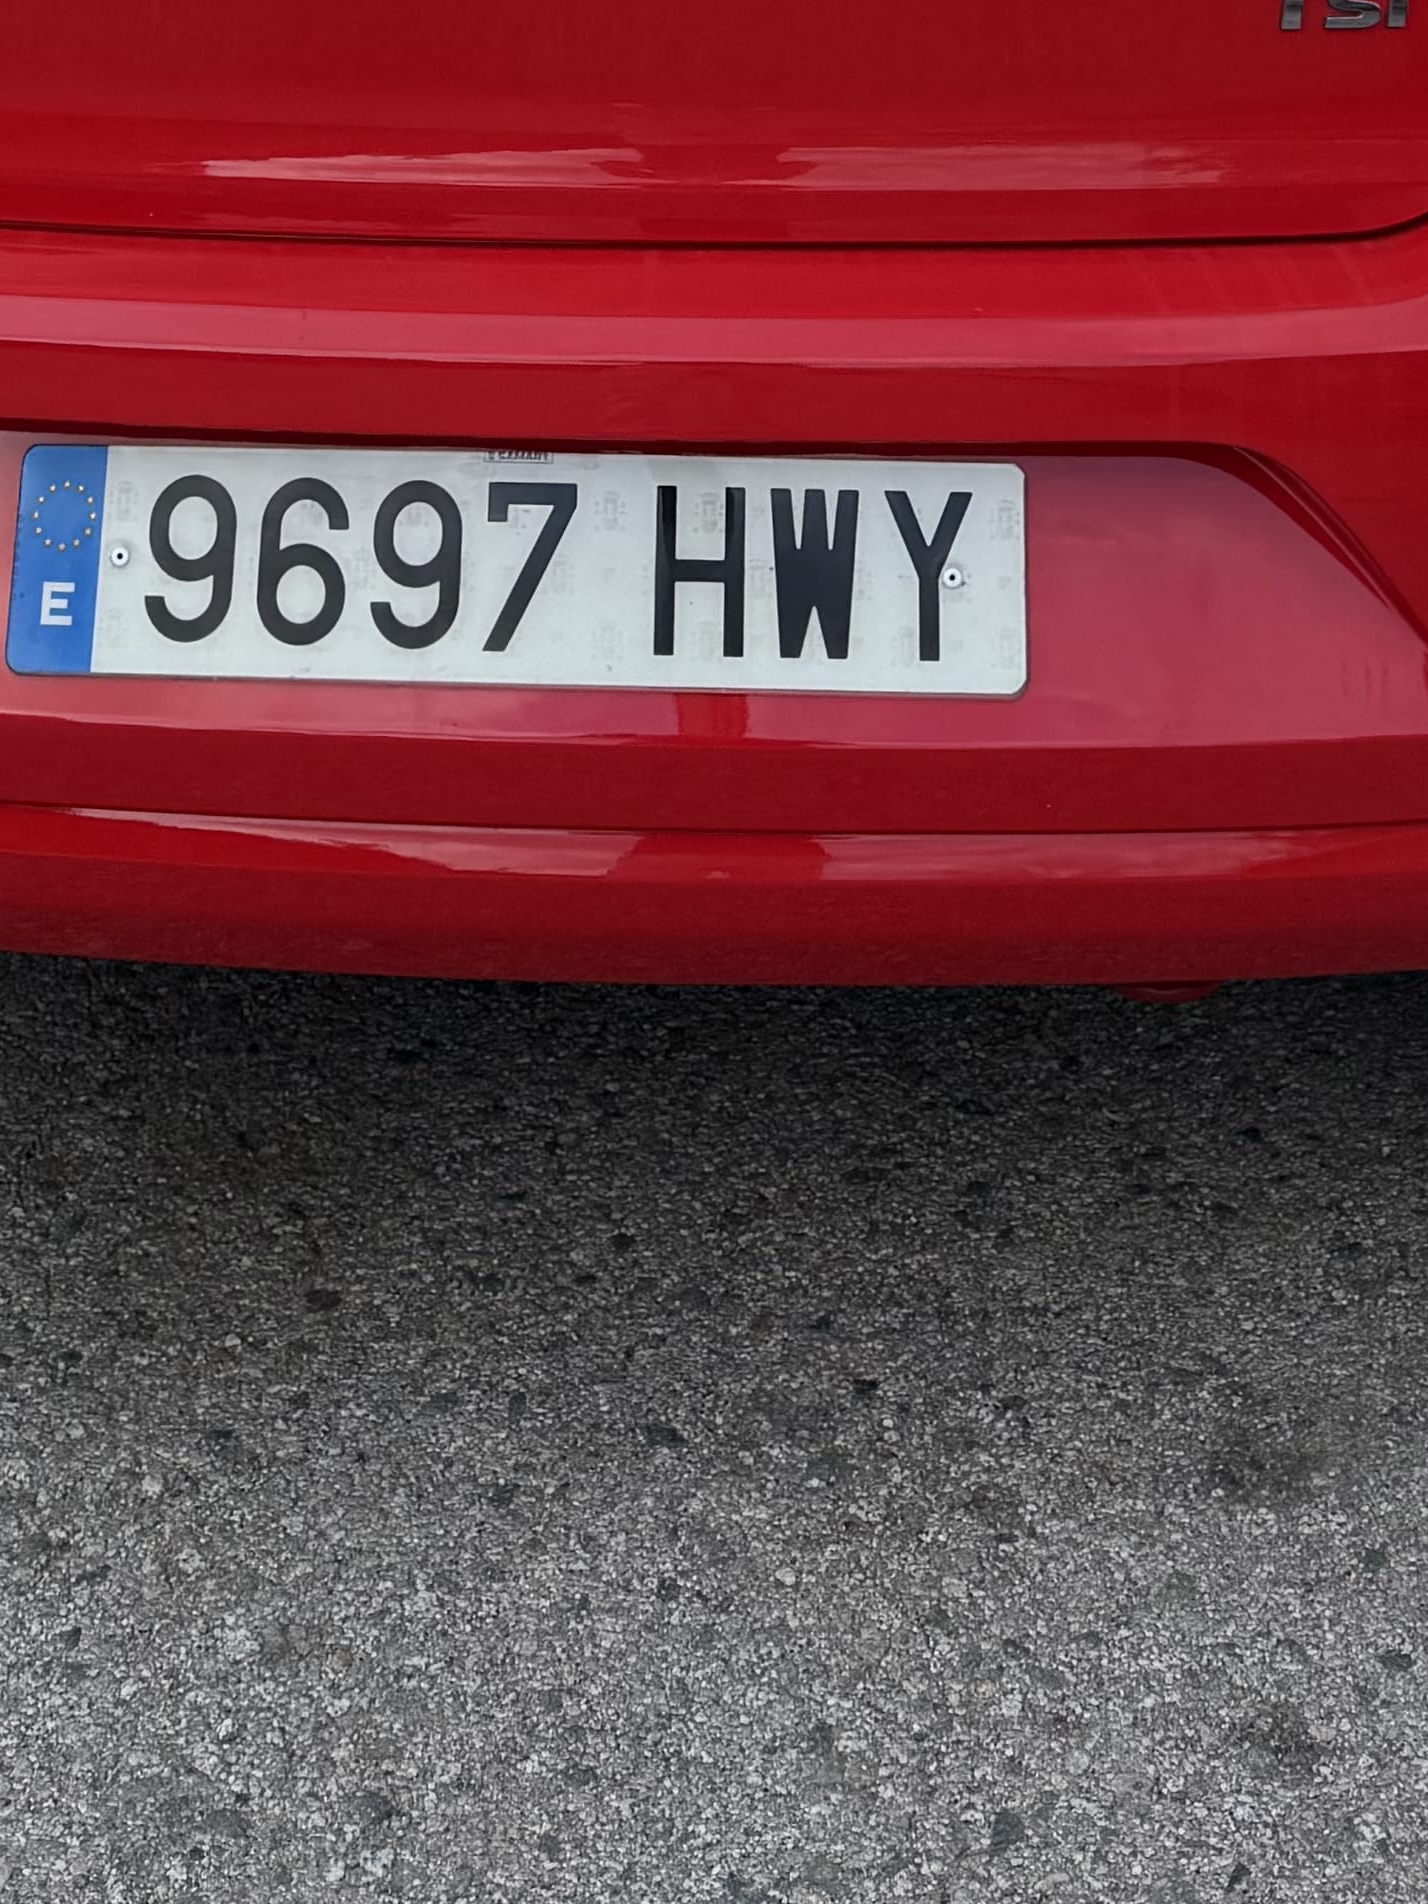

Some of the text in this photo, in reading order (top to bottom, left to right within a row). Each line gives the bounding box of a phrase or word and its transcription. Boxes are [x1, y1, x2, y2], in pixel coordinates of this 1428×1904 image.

[39, 474, 972, 661] E 9697 HWY
